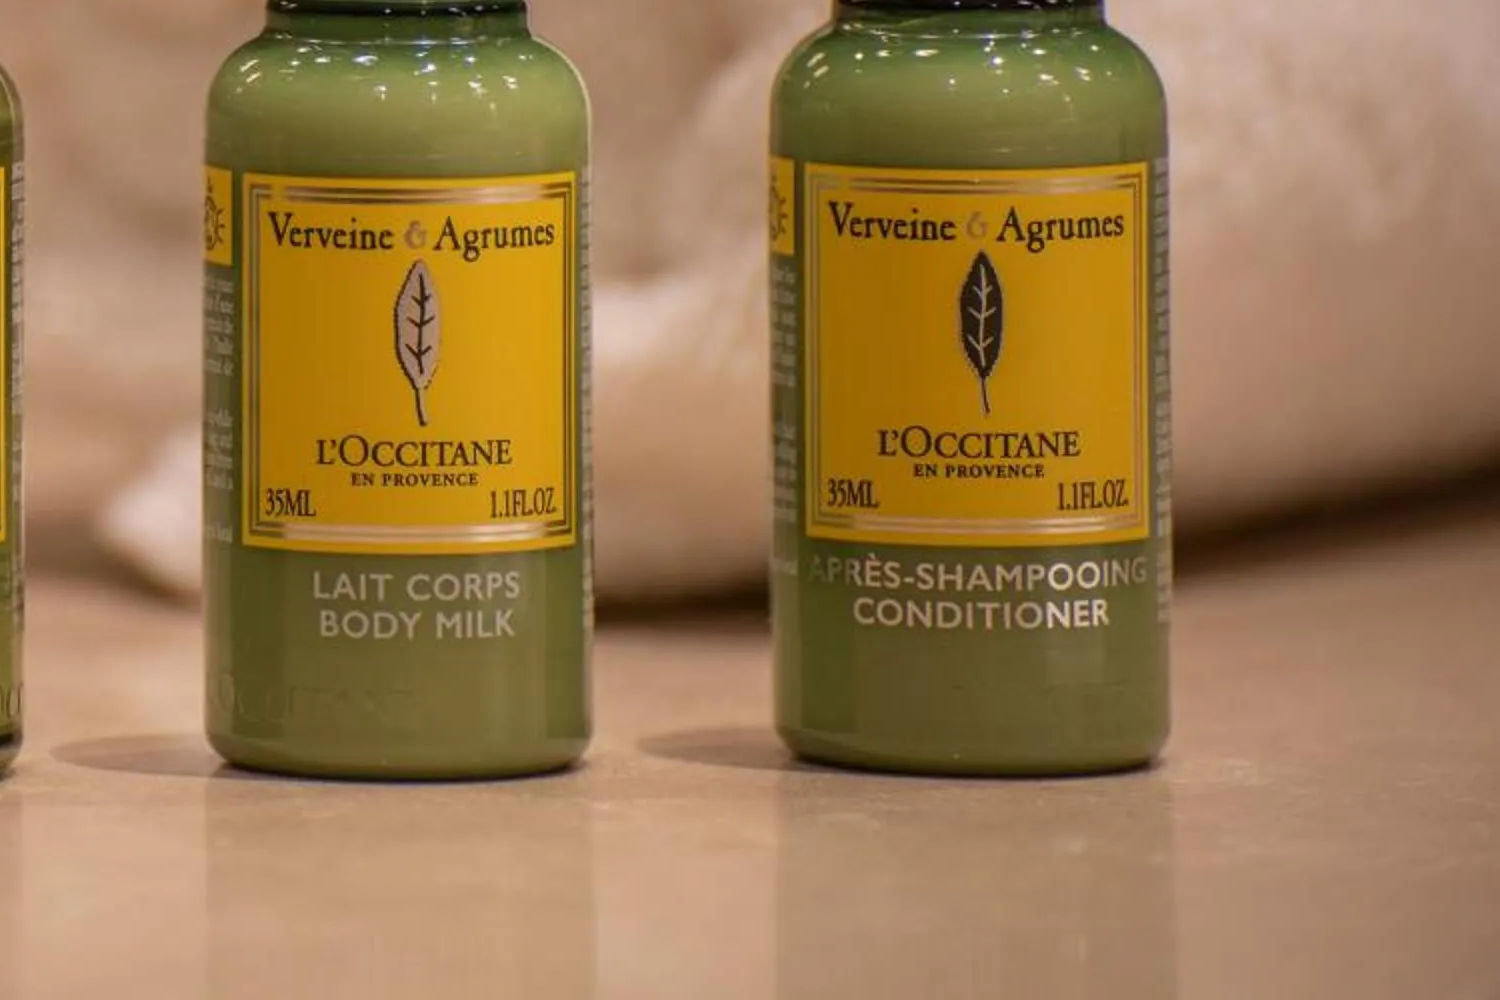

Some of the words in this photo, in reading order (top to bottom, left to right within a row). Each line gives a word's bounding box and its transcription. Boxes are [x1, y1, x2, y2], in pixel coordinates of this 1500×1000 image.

[268, 211, 393, 250] Verveine
[405, 220, 428, 249] &
[433, 215, 555, 262] Agrumes
[828, 201, 956, 241] Verveine
[965, 211, 988, 239] &
[996, 206, 1125, 253] Agrumes
[351, 473, 375, 487] EN
[382, 472, 478, 488] PROVENCE
[913, 464, 937, 477] EN
[945, 463, 1045, 479] PROVENCE
[313, 571, 394, 601] LAIT
[406, 571, 521, 600] CORPS
[808, 553, 1148, 593] APRÈS-SHAMPOOING
[320, 609, 421, 640] BODY
[436, 609, 517, 639] MILK
[853, 598, 1110, 630] CONDITIONER
